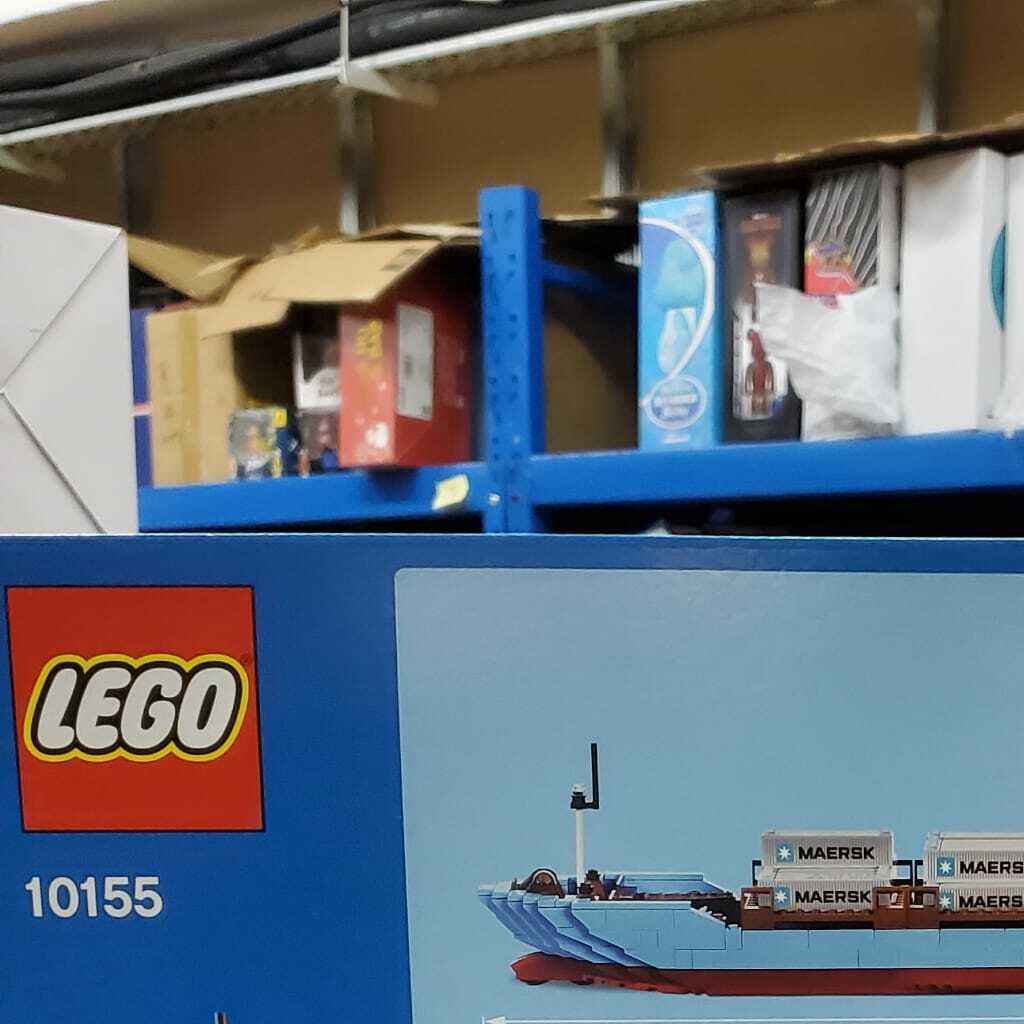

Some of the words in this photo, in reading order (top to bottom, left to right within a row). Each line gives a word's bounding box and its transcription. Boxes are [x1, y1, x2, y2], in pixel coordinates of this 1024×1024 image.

[31, 660, 243, 757] LEGO
[798, 846, 875, 861] MAERSK
[25, 876, 164, 918] 10155
[794, 889, 871, 904] MAERSK
